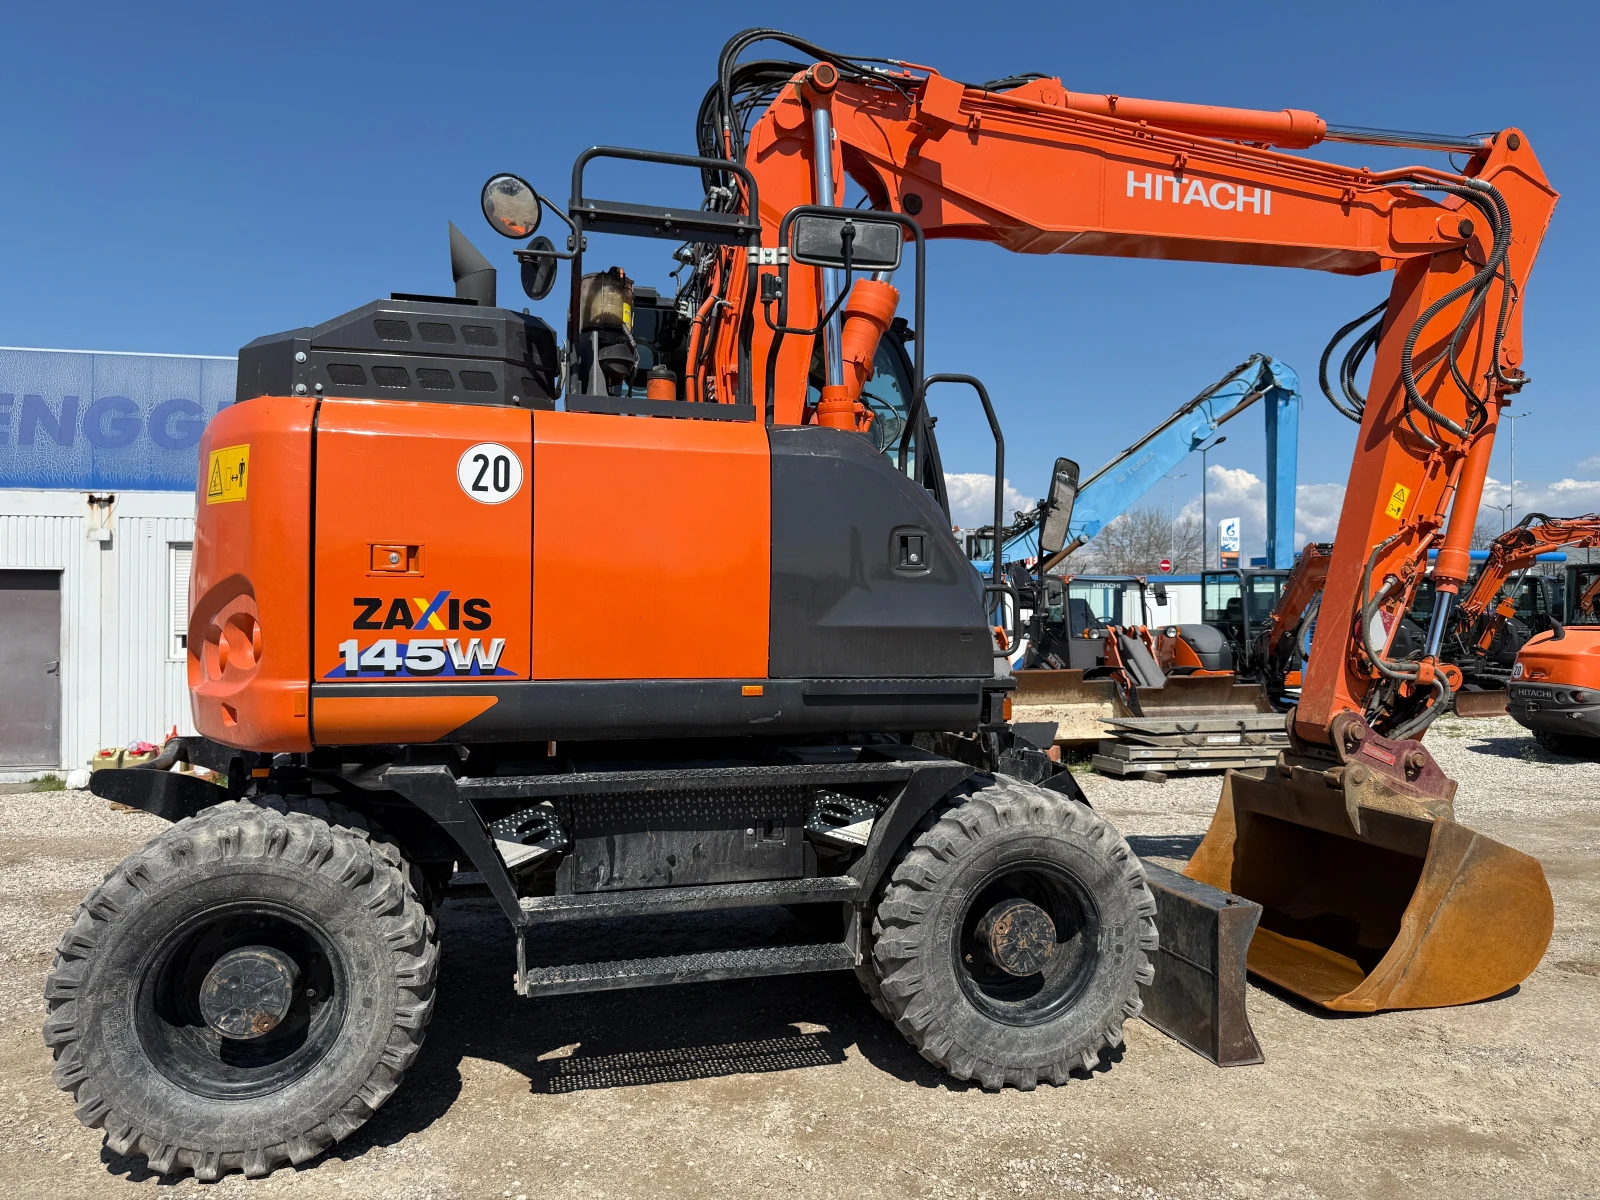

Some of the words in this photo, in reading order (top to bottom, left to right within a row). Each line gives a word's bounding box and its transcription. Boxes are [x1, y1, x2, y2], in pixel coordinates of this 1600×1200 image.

[1126, 170, 1272, 216] HITACHI
[472, 453, 511, 493] 20
[1126, 450, 1156, 475] TEREX
[353, 590, 492, 631] ZAXIS
[339, 637, 506, 675] 145W
[1514, 665, 1522, 676] 20
[1518, 688, 1552, 698] HITACHI
